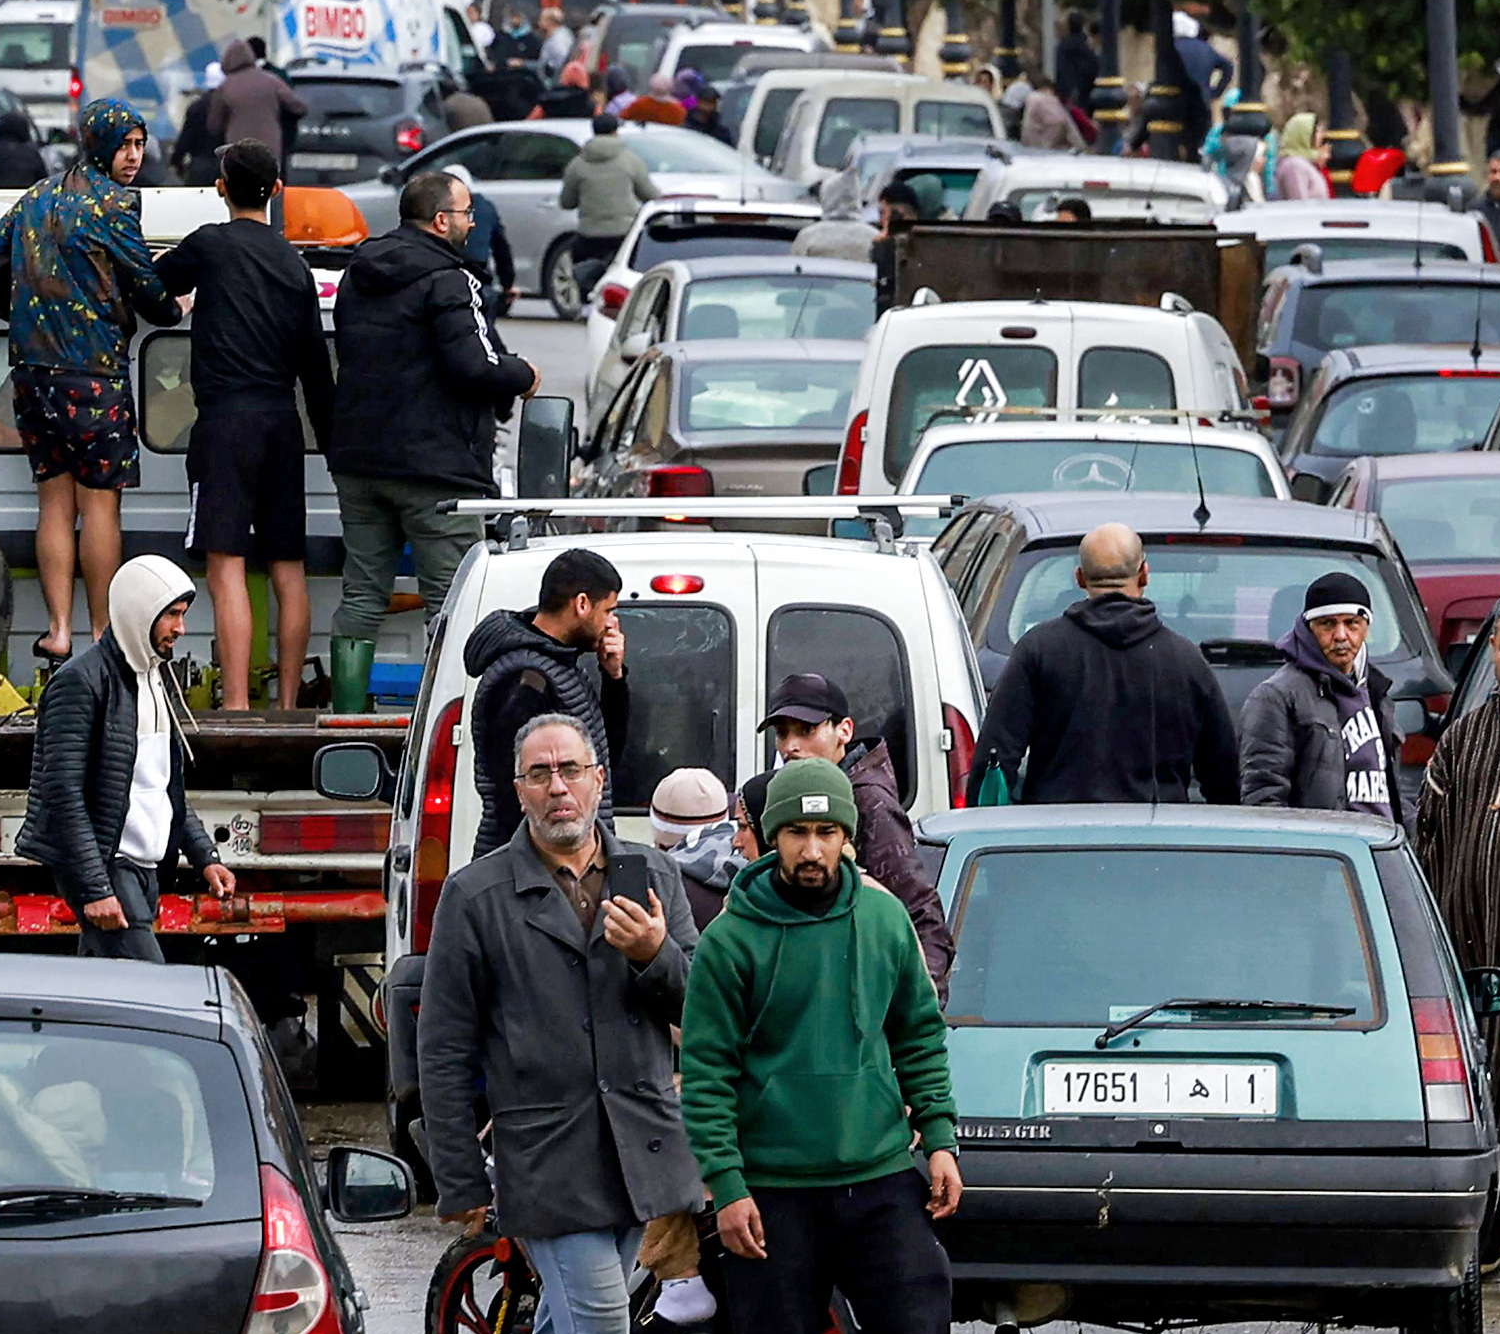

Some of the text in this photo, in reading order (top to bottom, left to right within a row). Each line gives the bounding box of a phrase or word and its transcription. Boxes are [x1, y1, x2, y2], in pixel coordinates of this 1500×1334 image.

[103, 7, 162, 25] BIMBO
[306, 4, 366, 40] BIMBO
[1063, 1071, 1138, 1103] 17651
[1247, 1073, 1256, 1104] 1
[953, 1124, 1051, 1139] AULT 5 GTR
